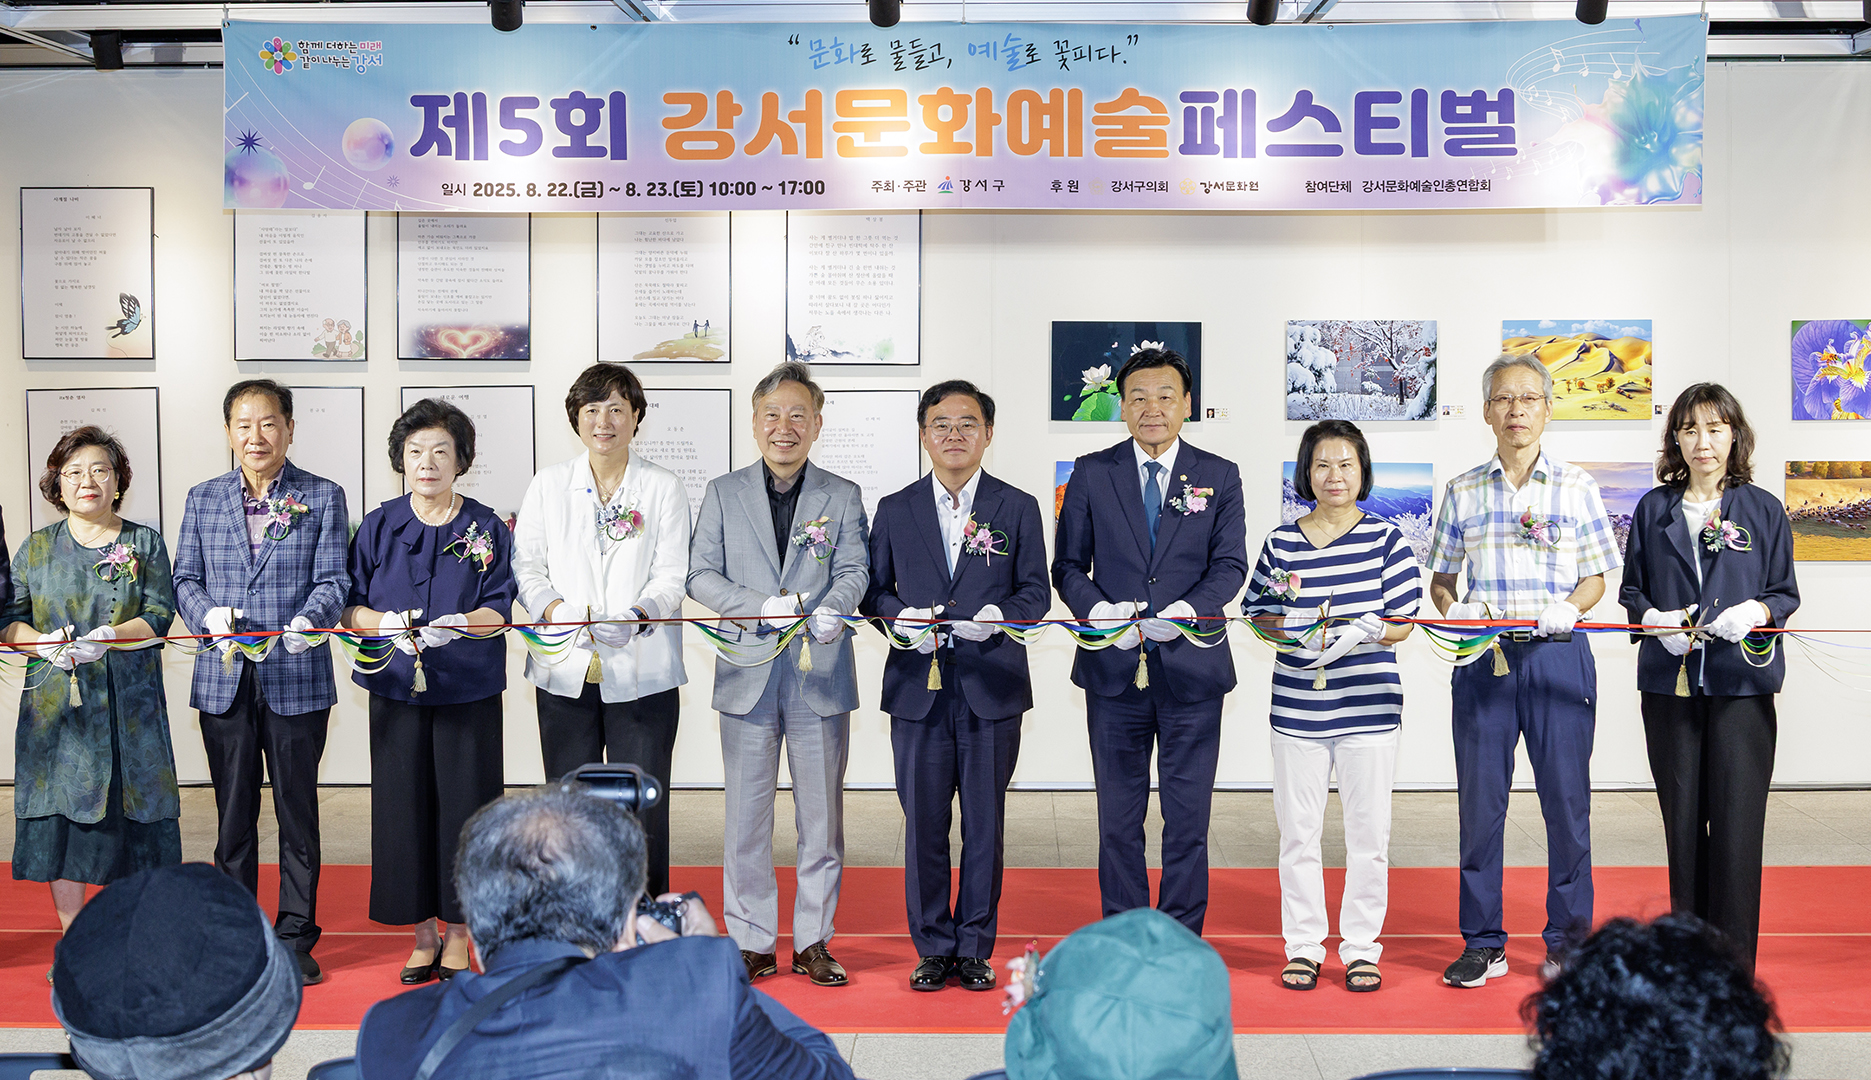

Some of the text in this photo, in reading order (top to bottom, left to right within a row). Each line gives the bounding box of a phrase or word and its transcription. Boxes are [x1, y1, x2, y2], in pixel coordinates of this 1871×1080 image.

[297, 40, 383, 65] 함께 더하는 미래
[889, 37, 953, 71] 물들고,
[967, 33, 1041, 71] 예술로
[299, 54, 383, 74] 같이 나누는 강서
[408, 86, 1520, 161] 제5회 강서문화예술페스티벌
[441, 183, 467, 197] 일시
[473, 182, 521, 198] 2025.
[526, 182, 542, 198] 8.
[547, 180, 604, 199] 22.(금)
[625, 182, 642, 198] 8.
[646, 180, 704, 199] 23.(토)
[709, 181, 757, 197] 10:00
[778, 180, 826, 196] 17:00
[871, 179, 927, 193] 주최·주관
[1110, 179, 1169, 194] 강서구의회
[1199, 180, 1259, 194] 강서문화원
[1305, 179, 1491, 193] 참여단체 강서문화예술인총연합회
